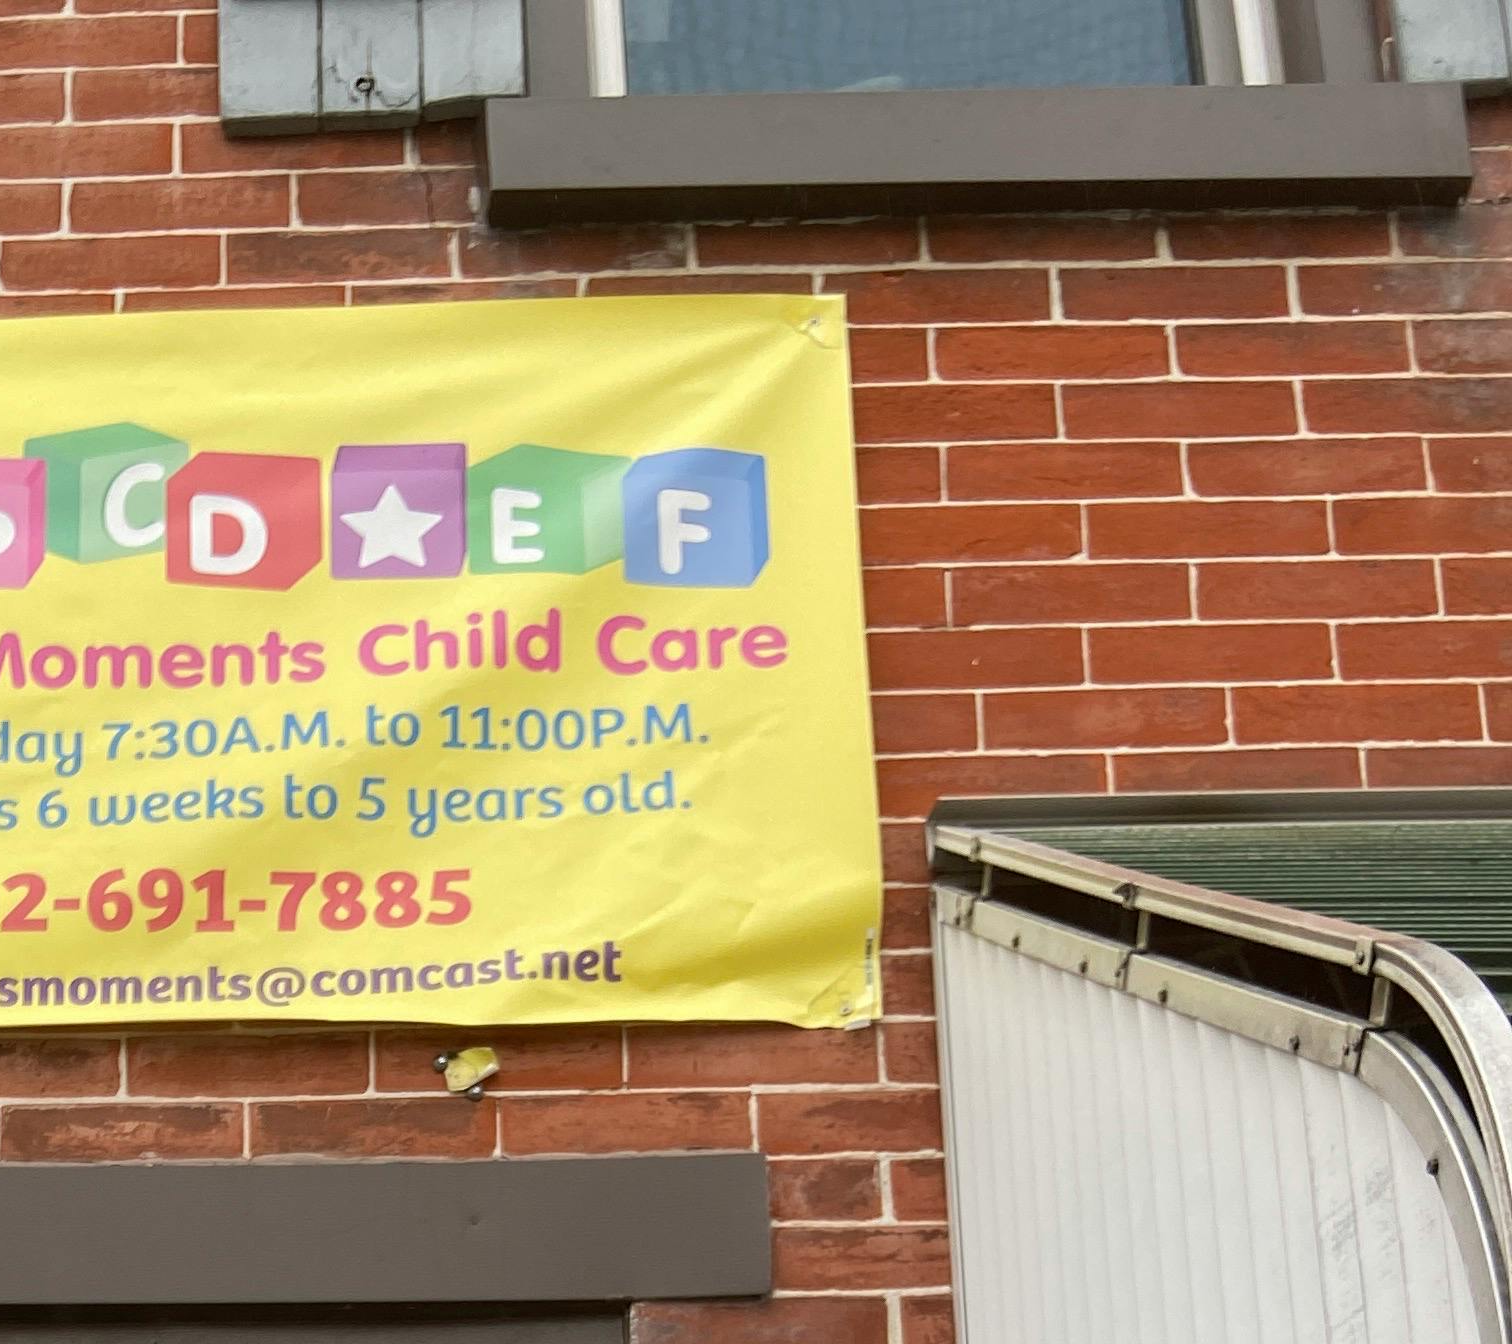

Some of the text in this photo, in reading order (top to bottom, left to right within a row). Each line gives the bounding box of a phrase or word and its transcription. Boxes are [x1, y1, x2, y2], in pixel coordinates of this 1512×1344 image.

[104, 462, 167, 547] C
[189, 494, 268, 575] D
[490, 486, 546, 565] E
[657, 488, 713, 575] F
[357, 608, 564, 679] Child
[596, 615, 791, 678] Care
[104, 709, 346, 763] 7:30A.M.
[365, 704, 424, 749] to
[439, 701, 710, 755] 11:00P.M.
[37, 788, 71, 831] 6
[88, 778, 268, 829] weeks
[284, 773, 342, 822] to
[358, 775, 389, 823] 5
[407, 785, 568, 840] years
[582, 768, 693, 819] old.
